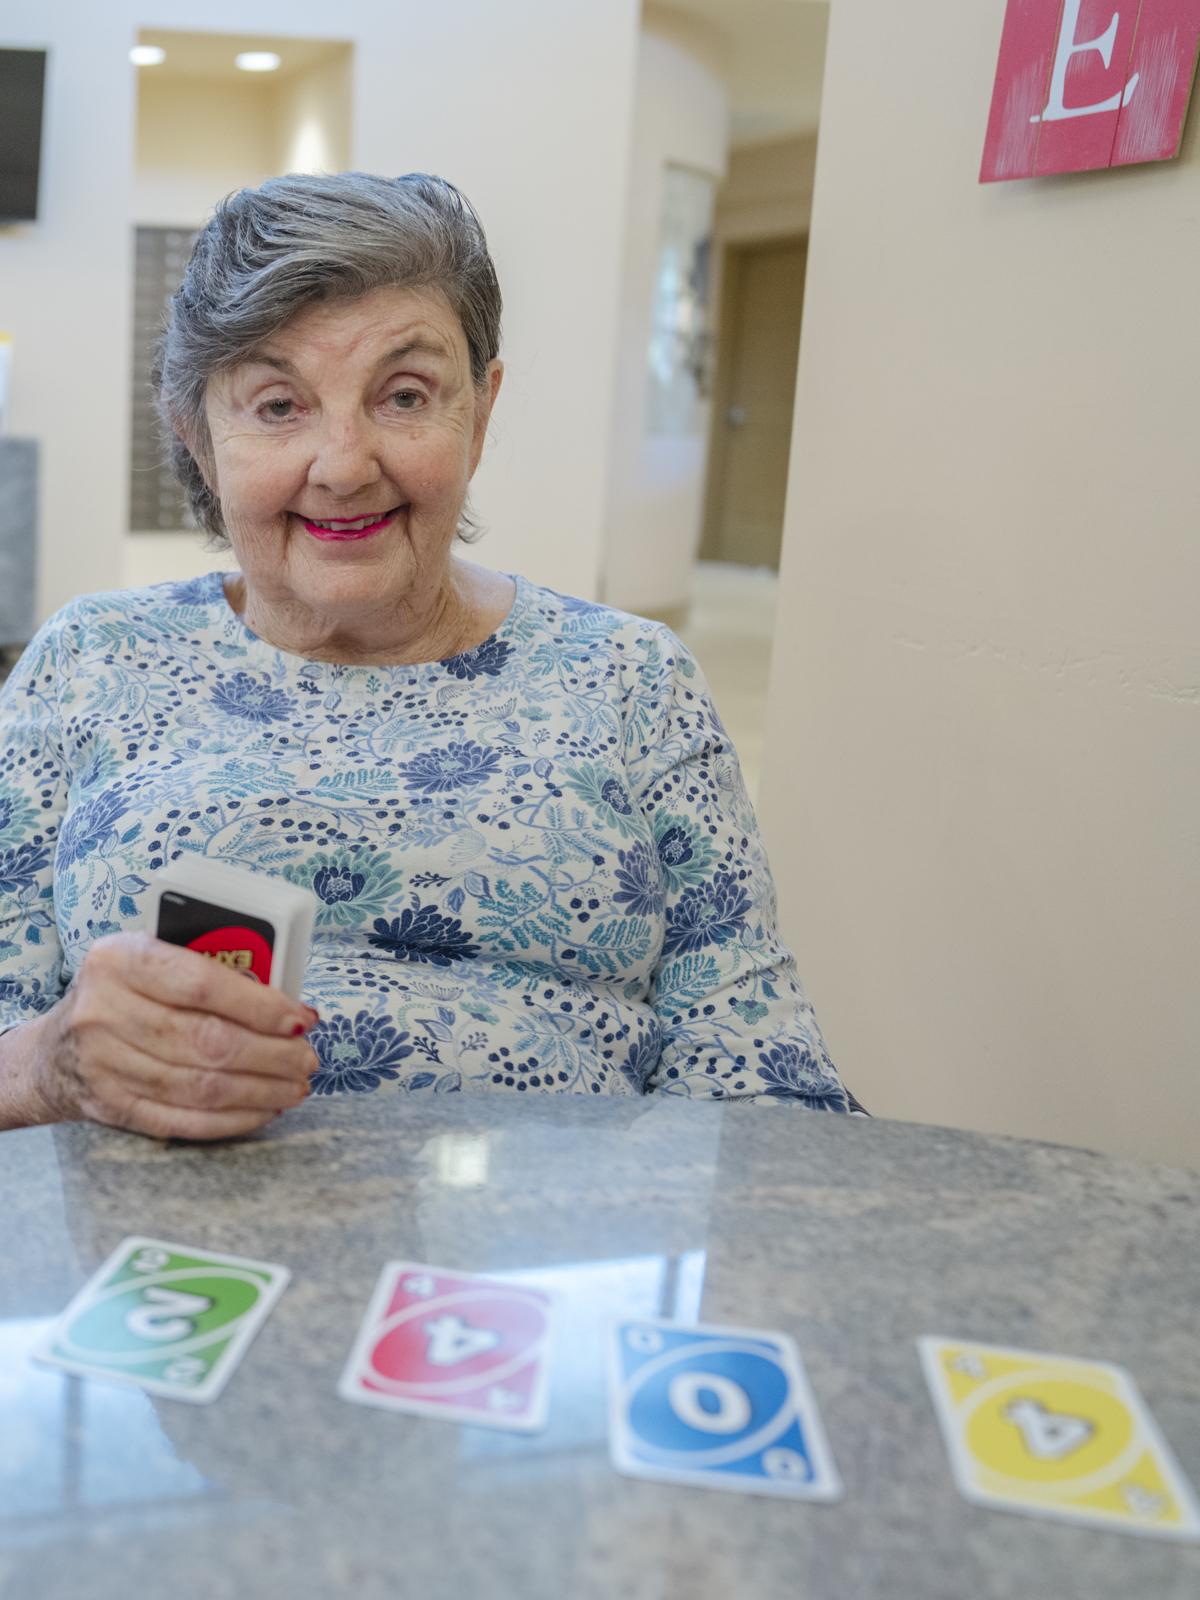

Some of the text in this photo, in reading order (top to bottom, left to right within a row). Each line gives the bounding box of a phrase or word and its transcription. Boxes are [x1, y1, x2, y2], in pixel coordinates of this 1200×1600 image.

[1029, 0, 1140, 123] E
[125, 1283, 217, 1342] 2
[421, 1313, 505, 1368] 4
[667, 1371, 752, 1435] 0
[1001, 1396, 1098, 1462] 4
